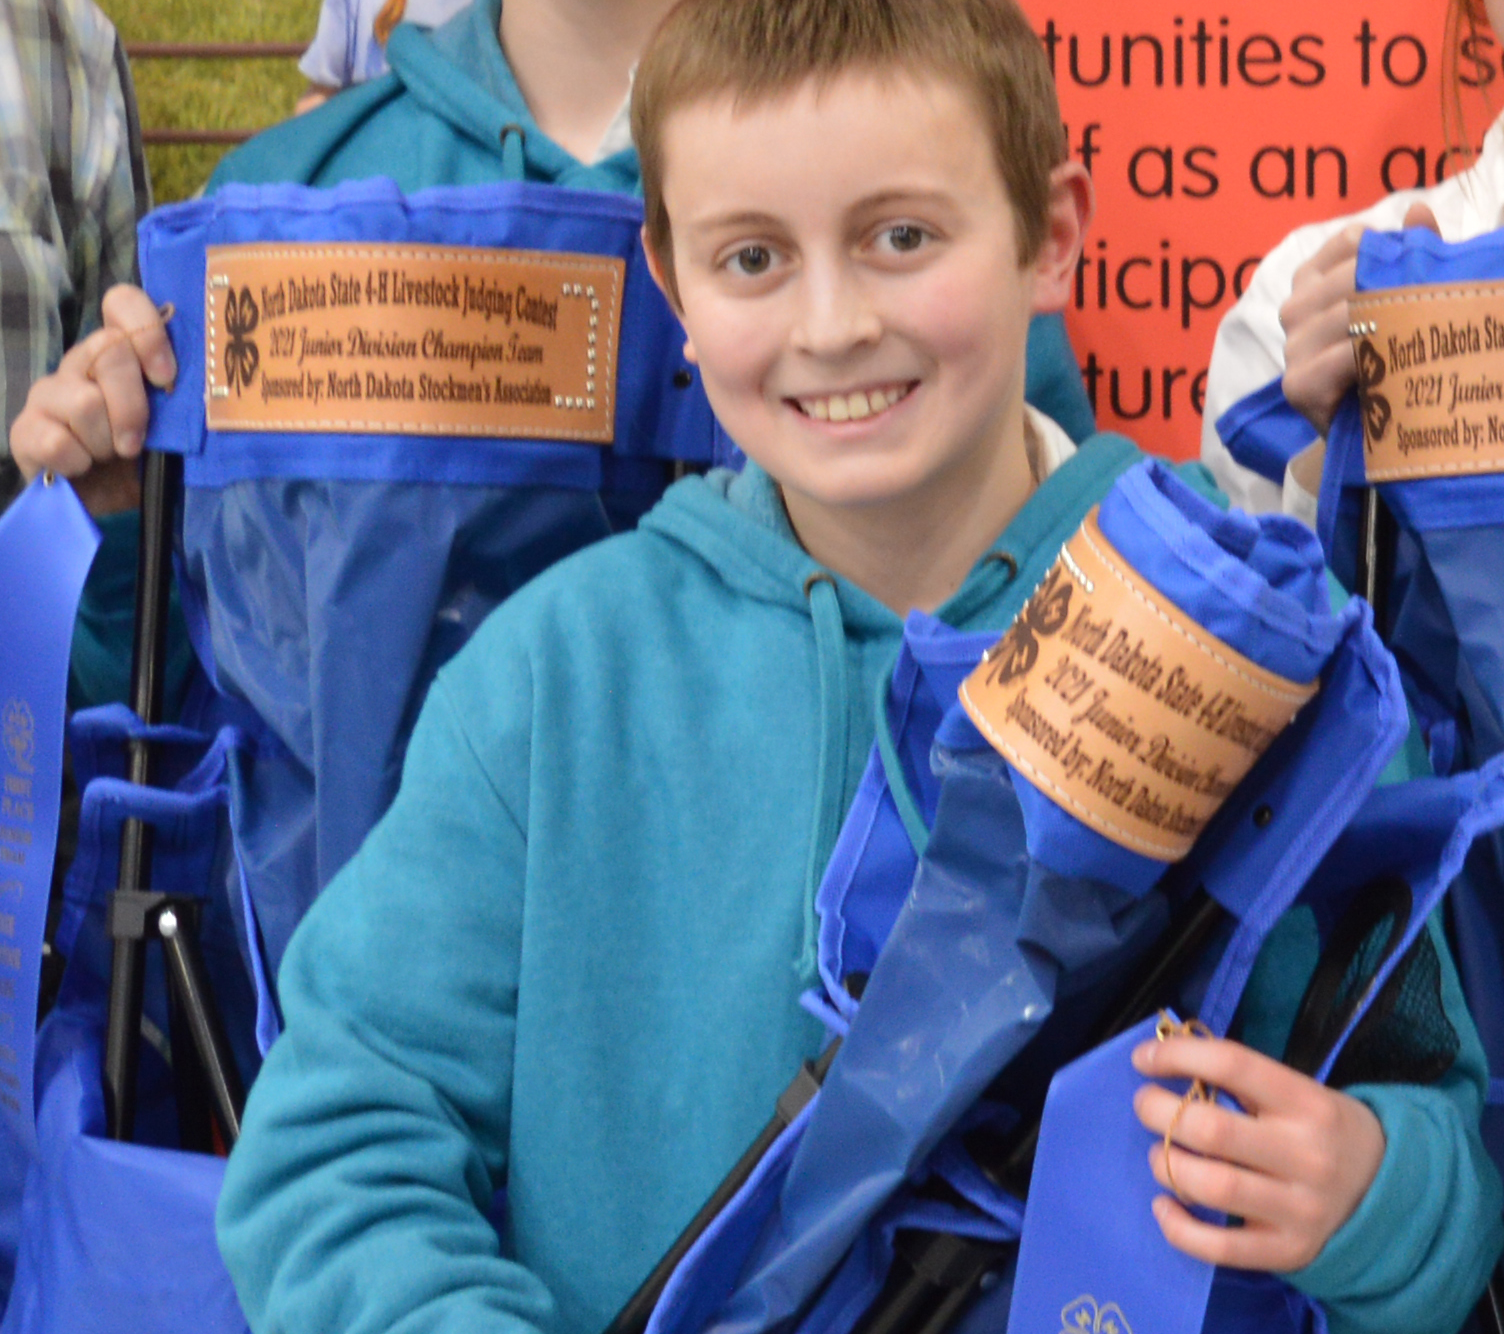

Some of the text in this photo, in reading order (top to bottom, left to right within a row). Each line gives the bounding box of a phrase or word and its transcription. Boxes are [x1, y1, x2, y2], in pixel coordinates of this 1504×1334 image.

[1354, 19, 1428, 88] to
[1127, 145, 1220, 198] as
[1250, 145, 1348, 198] an
[261, 270, 558, 332] North Dakota State 4-H Livestock Judging Contest
[298, 328, 343, 367] Junior
[346, 327, 417, 359] Division
[420, 329, 504, 370] Champion
[505, 331, 544, 365] Team
[1388, 327, 1426, 373] North
[1430, 319, 1481, 361] Dakota
[305, 373, 325, 405] by:
[327, 371, 362, 401] North
[365, 372, 414, 401] Dakota
[419, 373, 491, 404] Stockmen's
[494, 374, 552, 406] Association
[1404, 372, 1443, 409] 2021
[1446, 370, 1503, 414] Junior
[1396, 420, 1459, 456] Sponsored
[1462, 417, 1486, 451] by:
